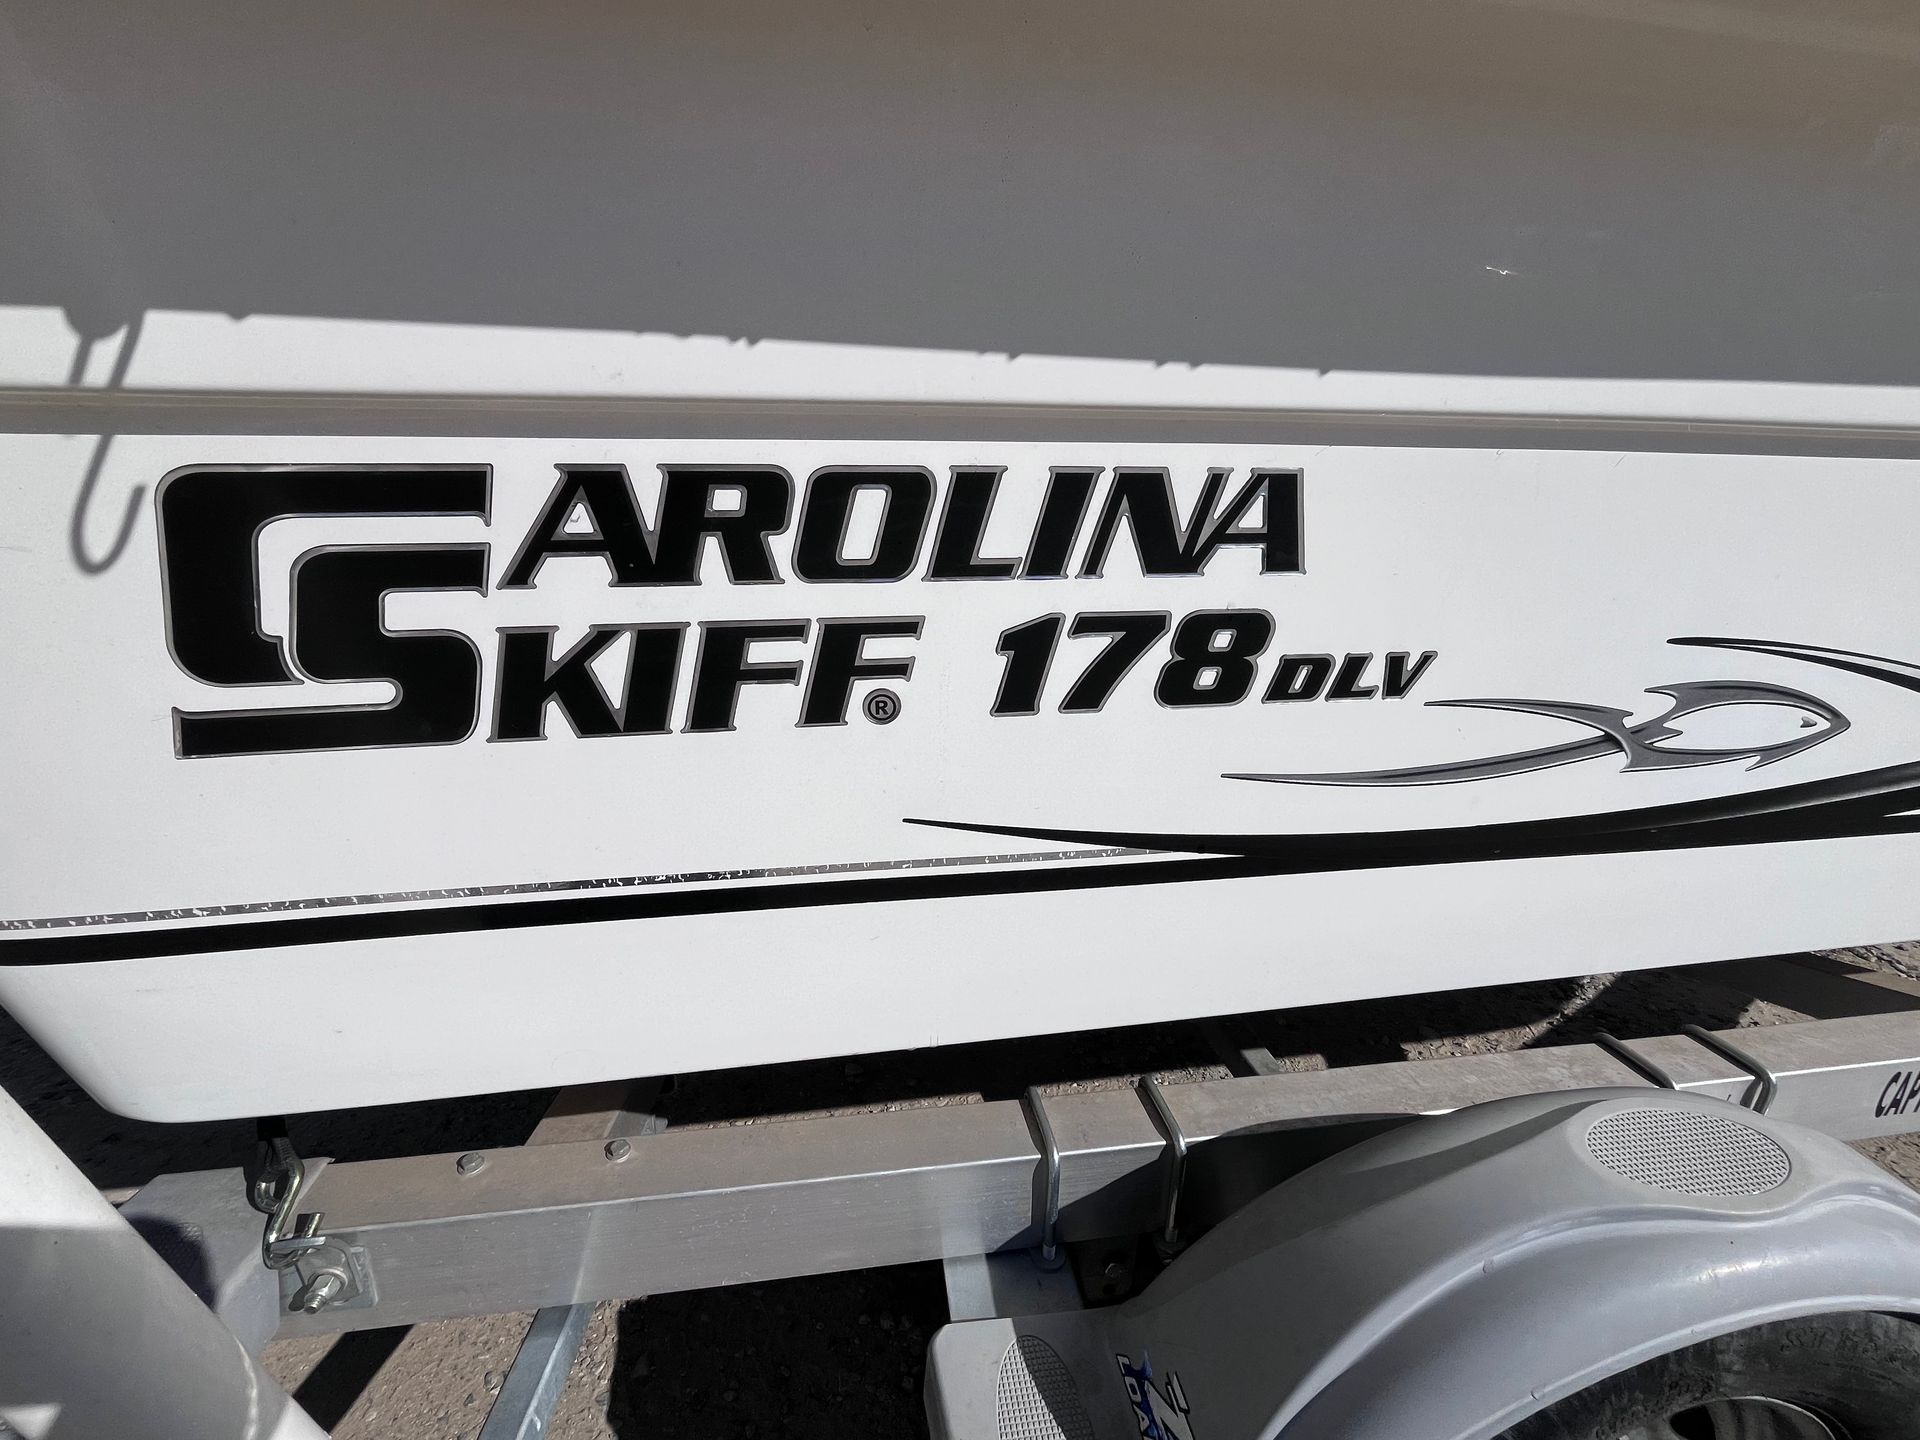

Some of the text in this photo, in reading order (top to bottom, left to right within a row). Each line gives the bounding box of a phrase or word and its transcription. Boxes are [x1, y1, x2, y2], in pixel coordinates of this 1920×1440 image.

[154, 463, 1306, 688] CAROLINA
[172, 541, 926, 760] SKIFF
[990, 608, 1277, 717] 178
[1261, 650, 1437, 704] DLV
